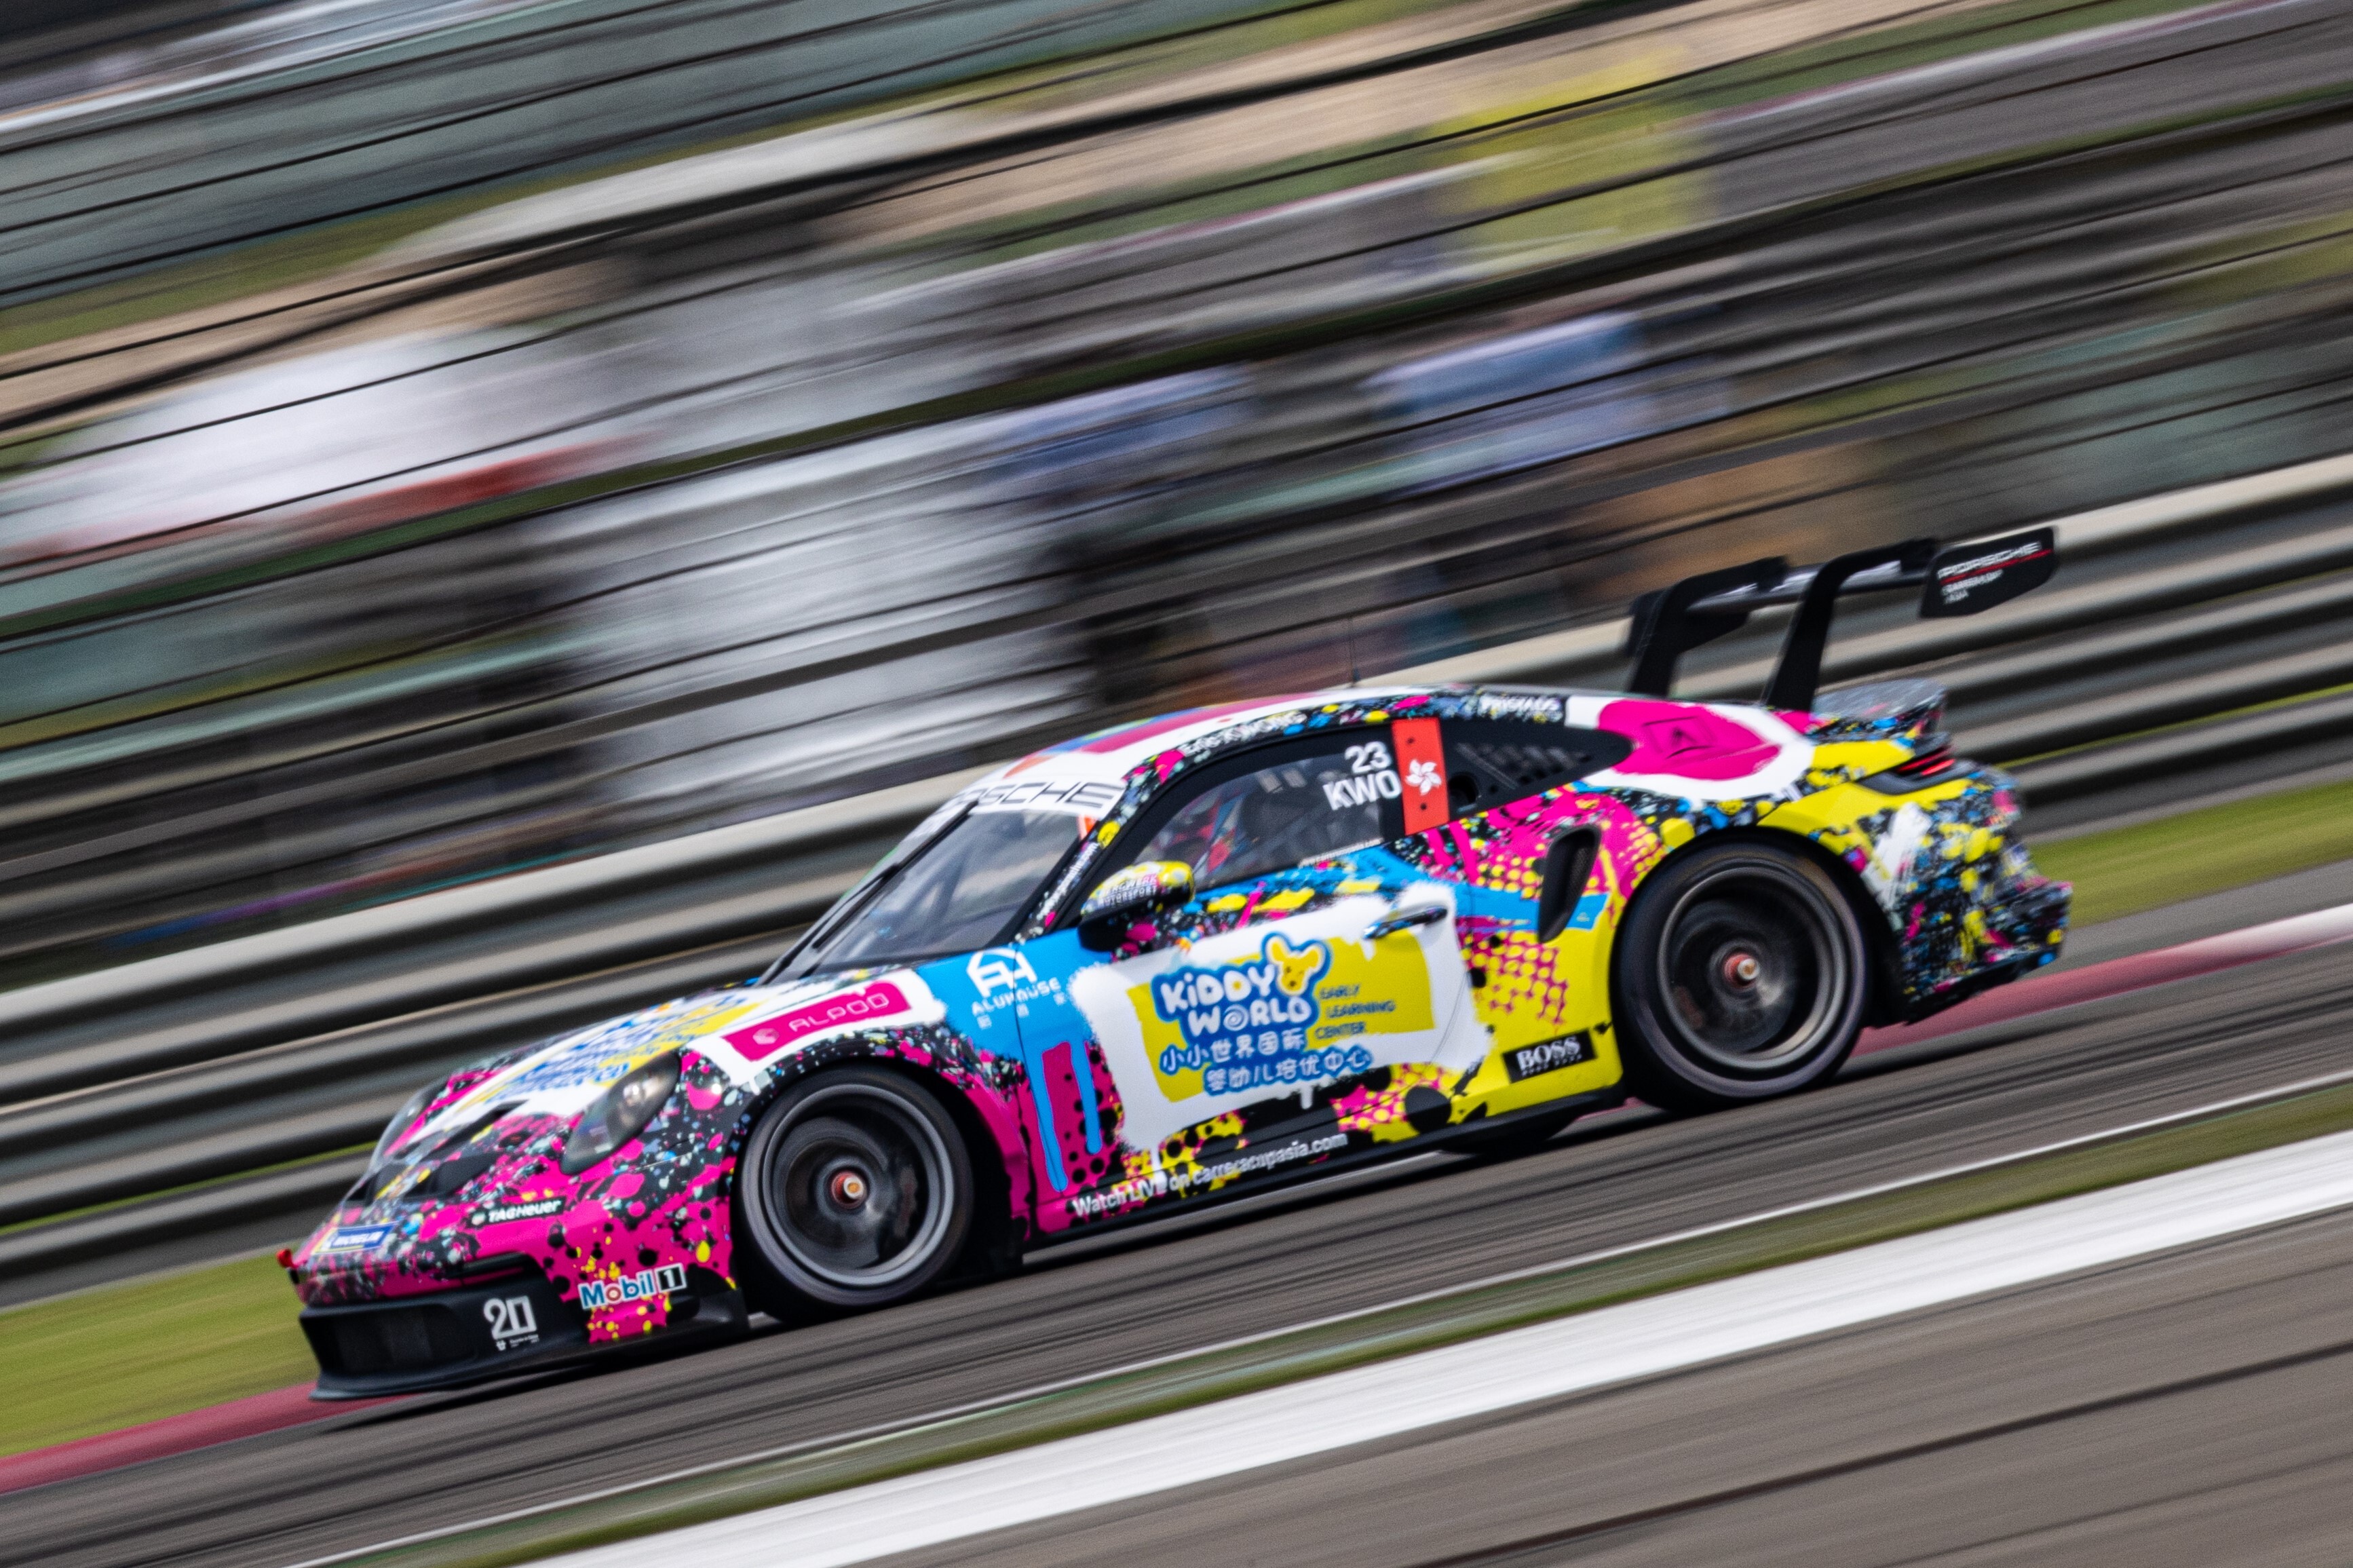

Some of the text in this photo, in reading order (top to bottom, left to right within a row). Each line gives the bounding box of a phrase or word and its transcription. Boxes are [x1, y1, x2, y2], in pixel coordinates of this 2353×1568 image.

[1345, 740, 1392, 774] 23
[1322, 769, 1402, 811] KWO
[1187, 996, 1312, 1037] WORLD
[1516, 1036, 1580, 1070] BOSS
[1073, 1191, 1124, 1217] Watch
[579, 1271, 655, 1308] Mobil
[484, 1296, 537, 1340] 20
